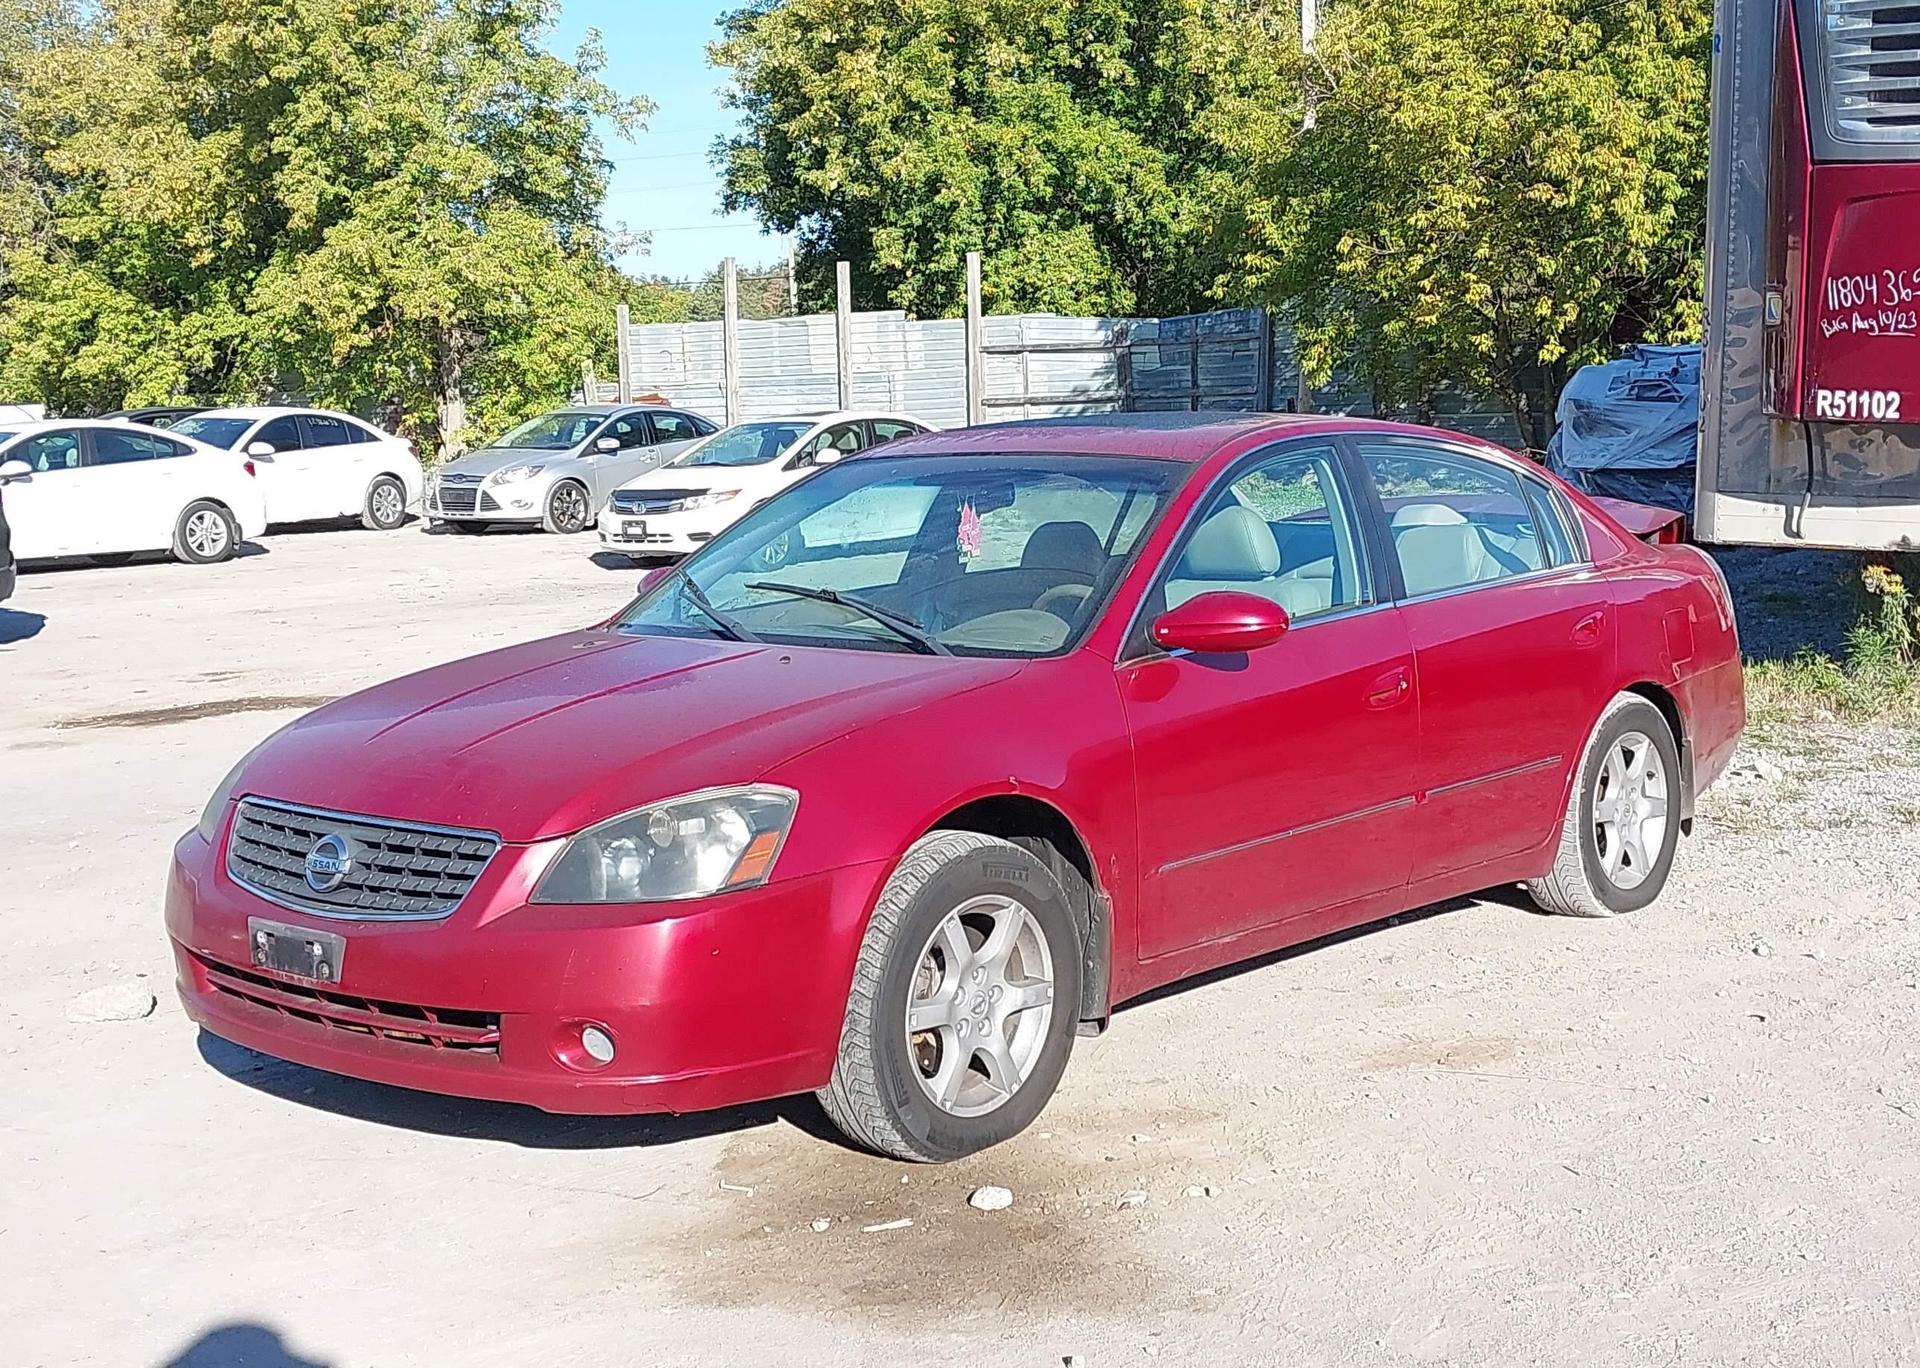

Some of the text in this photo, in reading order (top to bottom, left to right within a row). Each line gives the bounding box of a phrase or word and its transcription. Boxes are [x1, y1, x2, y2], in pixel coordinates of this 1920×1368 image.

[1827, 273, 1877, 311] 11804
[1852, 311, 1879, 336] Aug
[1878, 307, 1917, 333] 10/23
[1816, 389, 1900, 419] R51102
